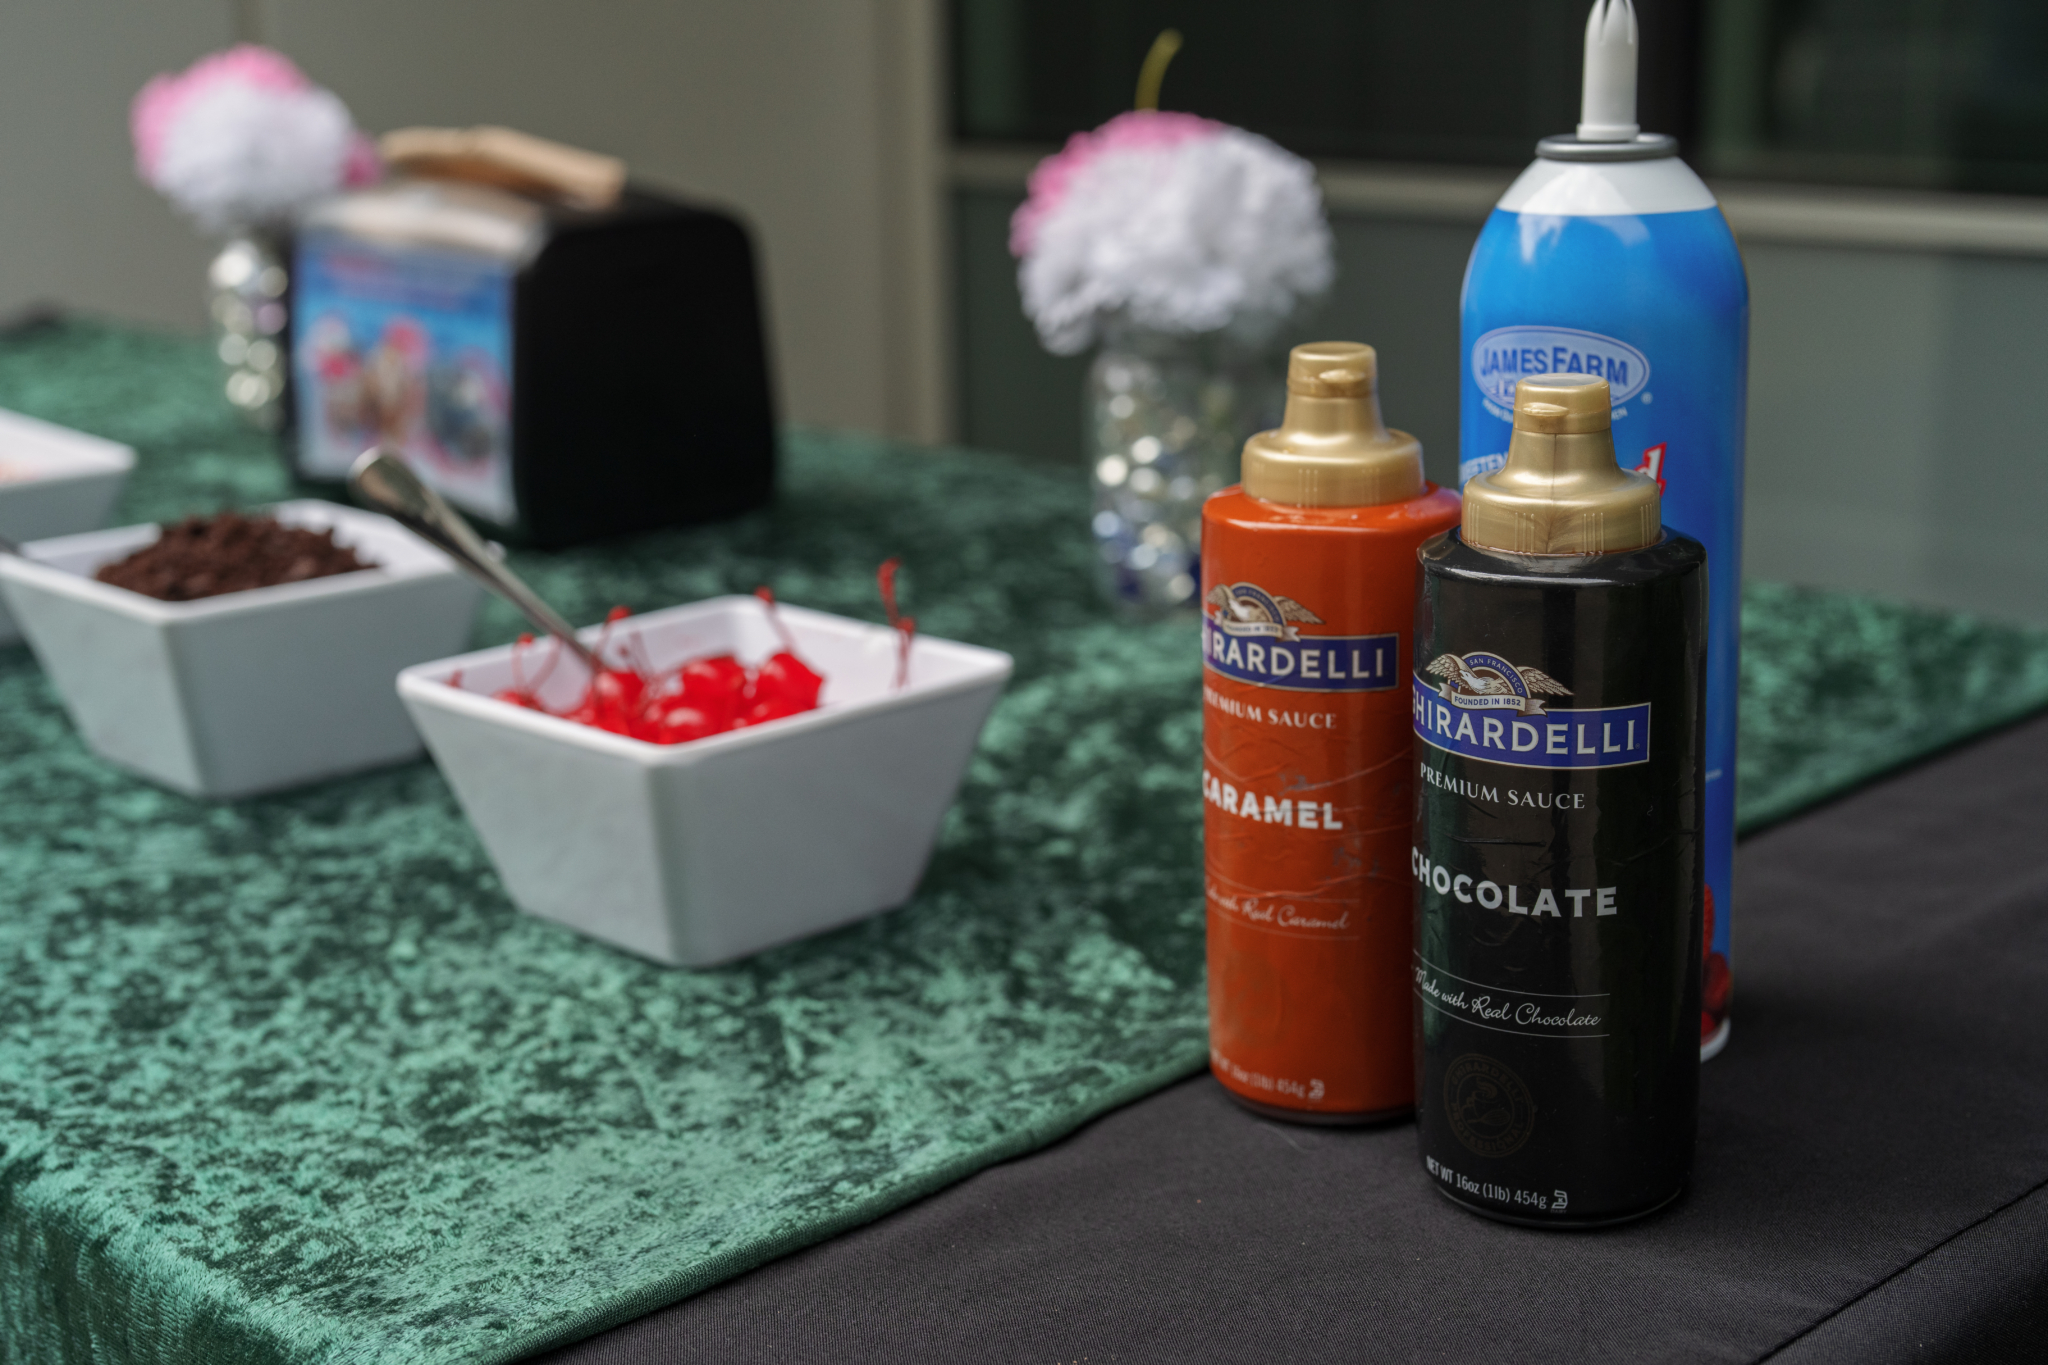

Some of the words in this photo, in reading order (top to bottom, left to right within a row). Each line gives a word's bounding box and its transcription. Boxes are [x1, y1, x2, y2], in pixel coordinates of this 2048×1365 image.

[1469, 657, 1485, 666] SAN
[1487, 657, 1524, 695] FRANCISCO
[1268, 708, 1337, 729] SAUCE
[1454, 696, 1489, 706] FOUNDED
[1491, 698, 1500, 706] IN
[1503, 698, 1521, 707] 1852
[1202, 769, 1344, 831] CARAMEL
[1420, 761, 1500, 803] PREMIUM
[1507, 789, 1586, 810] SAUCE
[1411, 846, 1618, 918] CHOCOLATE
[1277, 904, 1352, 930] Caramel
[1414, 966, 1441, 998] Made
[1441, 991, 1469, 1009] with
[1472, 995, 1512, 1020] Real
[1515, 1002, 1601, 1026] Chocolate
[1426, 1155, 1440, 1176] NET
[1440, 1165, 1453, 1184] WT
[1456, 1173, 1480, 1194] 16oz
[1482, 1183, 1510, 1202] (1lb)
[1514, 1189, 1547, 1210] 454g
